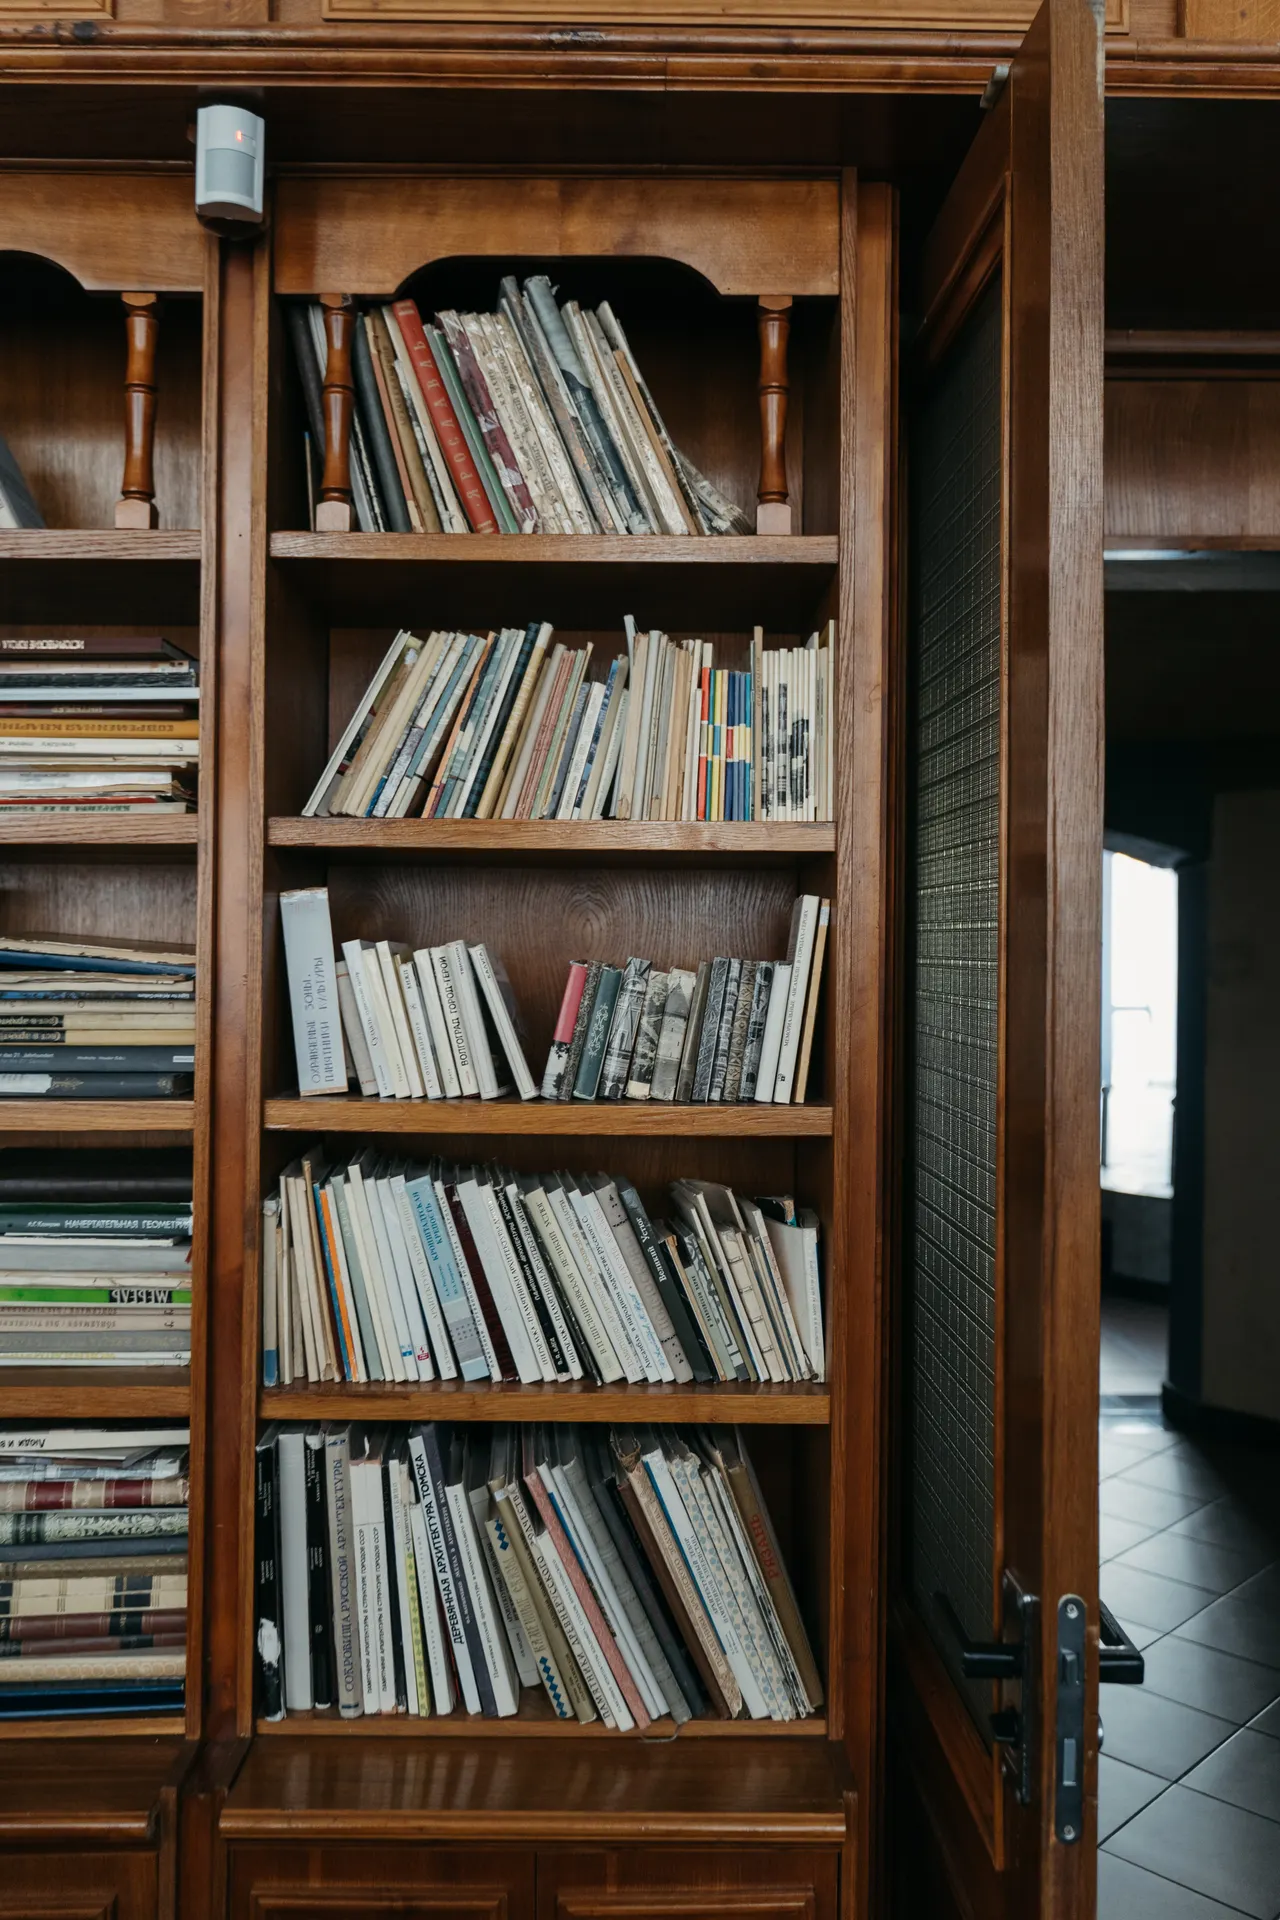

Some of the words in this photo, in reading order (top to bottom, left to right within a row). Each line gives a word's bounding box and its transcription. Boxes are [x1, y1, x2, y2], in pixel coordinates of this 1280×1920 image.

[414, 339, 479, 502] ЯРОСЛАВЛЬ
[65, 723, 174, 732] СОВРЕМЕННАЯ
[313, 957, 327, 1010] КУЛЬТУРЫ
[438, 956, 458, 1014] ГОРОД-ГЕРОЙ
[477, 952, 492, 979] КАЛУГА
[784, 1001, 795, 1047] МЕМОРИАЛЬНЫЕ
[791, 966, 800, 997] АНСАМБЛИ
[307, 1020, 321, 1084] ОХРАНЯЕМЫЕ
[319, 1022, 334, 1082] ПАМЯТНИКИ
[451, 1017, 469, 1067] ВОЛГОГРАД
[65, 1220, 138, 1229] НАЧЕРТАТЕЛЬНАЯ
[412, 1191, 439, 1261] КРОНШТАДТСКАЯ
[424, 1203, 443, 1245] КРЕПОСТЬ
[535, 1201, 552, 1228] УСТЮГ
[559, 1199, 576, 1230] ОБЛАСТИ
[634, 1215, 651, 1242] Устюг
[453, 1241, 468, 1278] ЗОДЧЕСТВА
[495, 1225, 517, 1275] АРХИТЕКТУРЫ
[508, 1222, 528, 1263] АРХИТЕКТУРЫ
[522, 1225, 545, 1275] АРХИТЕКТУРЫ
[548, 1231, 569, 1268] ВЕЛИКИЙ
[572, 1231, 596, 1276] МОСКОВСКОЙ
[585, 1222, 604, 1255] русского
[523, 1264, 541, 1301] ПАМЯТНИКИ
[599, 1255, 619, 1291] зодчестве
[647, 1245, 667, 1282] Великий
[111, 1290, 169, 1303] МЕБЕЛЬ
[419, 1268, 440, 1319] АРХИТЕКТУРА
[465, 1281, 482, 1326] ДЕРЕВЯННОГО
[512, 1275, 535, 1323] ПАМЯТНИКИ
[540, 1274, 562, 1321] ПАМЯТНИКИ
[566, 1273, 601, 1341] ШИЛЬНИКОВСКАЯ
[590, 1275, 616, 1324] АРХИТЕКТУРЫ
[614, 1291, 634, 1327] народном
[480, 1331, 495, 1368] ПАМЯТНИКИ
[611, 1324, 635, 1368] ПАМЯТНИКИ
[632, 1334, 653, 1370] Ансамбль
[18, 1438, 46, 1449] Люди
[414, 1454, 432, 1499] ТОМСКА
[333, 1458, 347, 1552] АРХИТЕКТУРЫ
[424, 1501, 448, 1575] АРХИТЕКТУРА
[652, 1507, 677, 1555] ЗОДЧЕСТВА
[683, 1536, 696, 1559] ДЕКОР
[748, 1513, 780, 1581] РЯЗАНЬ
[690, 1534, 711, 1579] УЗБЕКИСТАНА
[337, 1555, 350, 1612] РУССКОЙ
[536, 1554, 580, 1647] ДРЕВНЕРУССКОГО
[673, 1558, 701, 1612] АРМЯНСКОГО
[693, 1559, 718, 1615] АРХИТЕКТУРНЫЙ
[707, 1579, 729, 1624] ПАМЯТНИКОВ
[440, 1577, 464, 1646] ДЕРЕВЯННАЯ
[341, 1615, 355, 1693] СОКРОВИЩА
[697, 1615, 724, 1668] ПАМЯТНИКИ
[576, 1652, 611, 1720] ПАМЯТНИКИ
